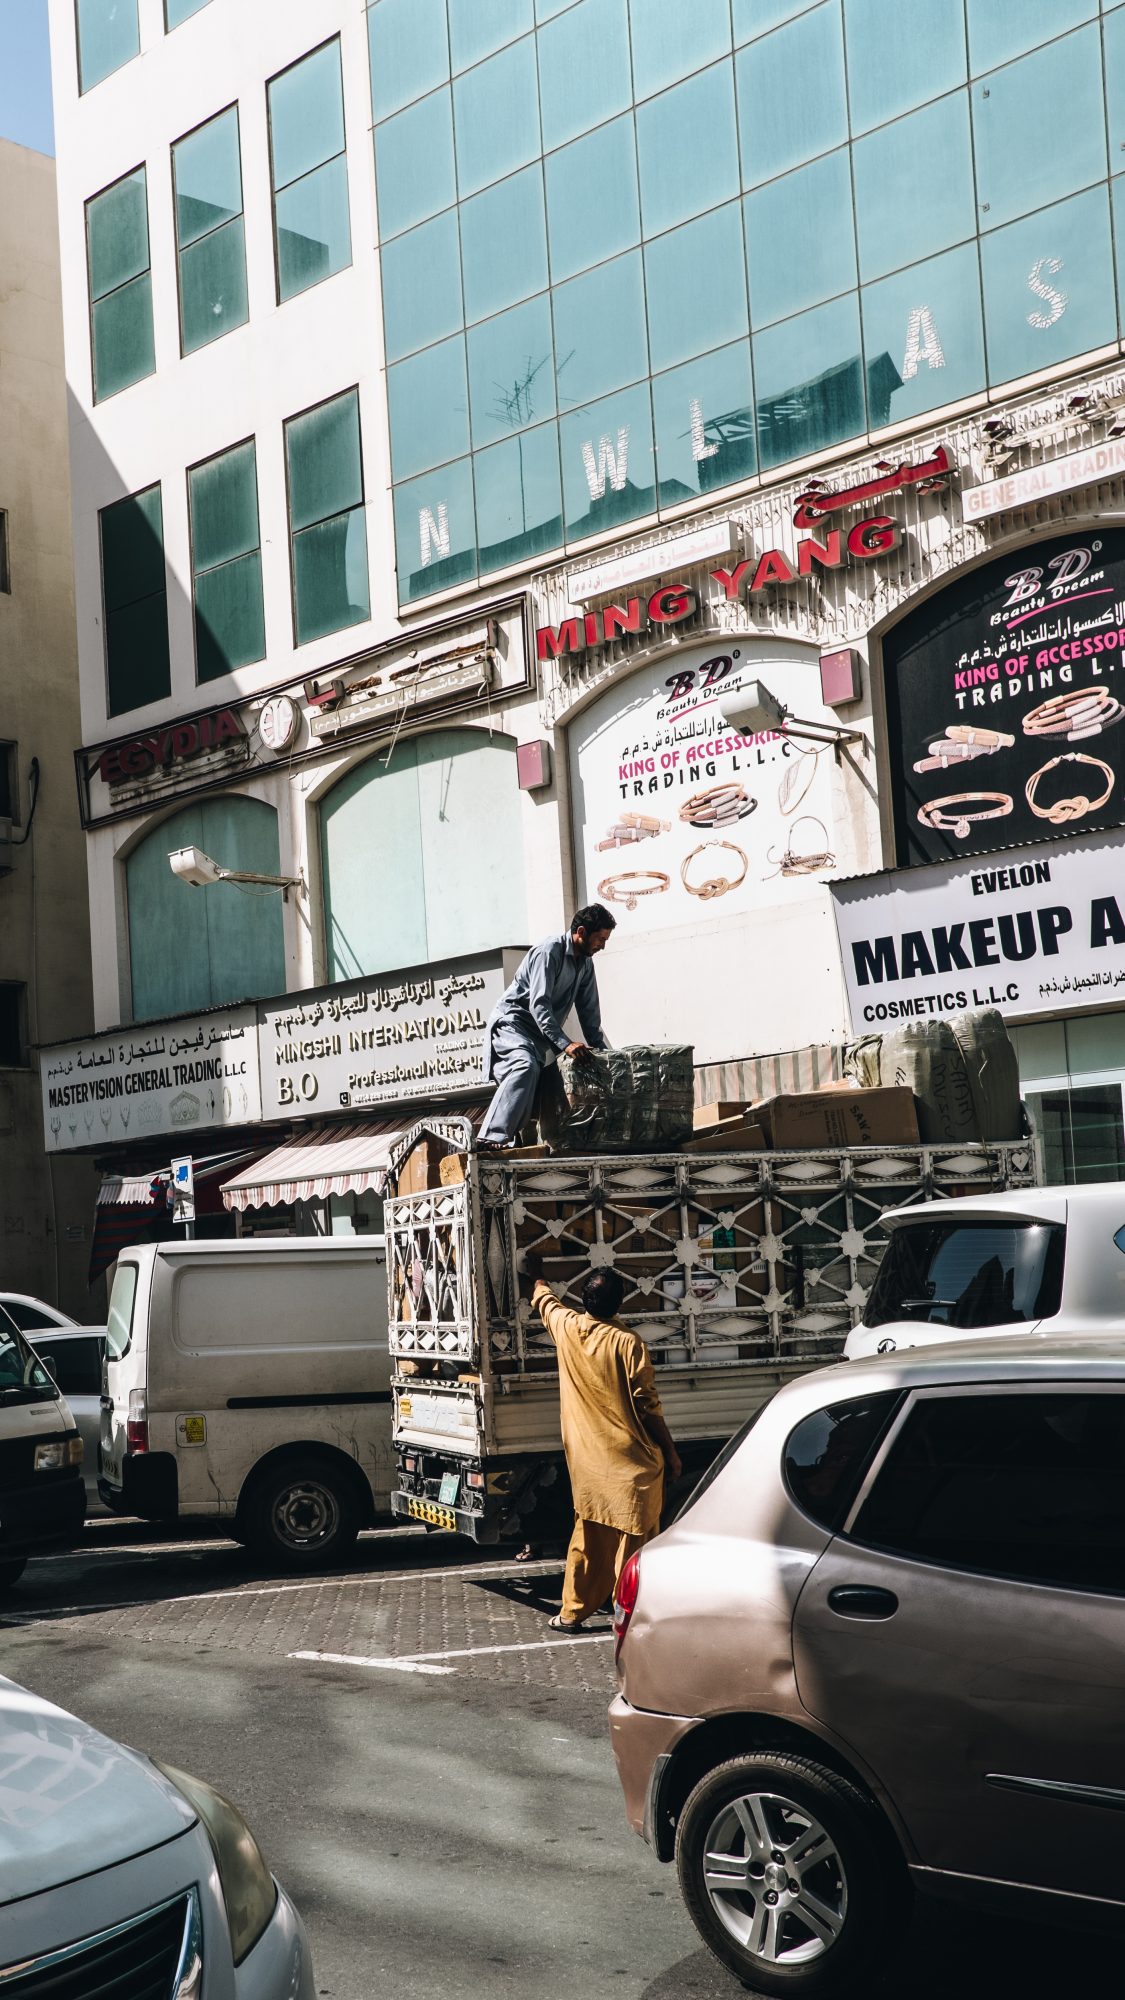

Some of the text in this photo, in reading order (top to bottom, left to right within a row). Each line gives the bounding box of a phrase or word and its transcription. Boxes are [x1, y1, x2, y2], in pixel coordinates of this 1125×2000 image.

[418, 499, 451, 566] N
[579, 424, 631, 502] W
[903, 304, 946, 382] A
[1026, 256, 1070, 330] S
[967, 470, 1052, 513] GENERAL
[536, 515, 902, 661] MING YANG
[990, 570, 1105, 626] Beauty Dream
[1010, 622, 1048, 652] للتجارة
[954, 663, 999, 690] KING
[1005, 654, 1030, 676] OF
[955, 664, 1073, 710] TRADING
[656, 676, 743, 721] Beauty Dream
[99, 708, 246, 783] EGYDIA
[665, 721, 696, 747] للتجارة
[618, 757, 656, 781] KING
[661, 750, 680, 769] OF
[619, 761, 717, 800] TRADING
[971, 861, 1052, 896] EVELON
[851, 905, 1073, 986] MAKEUP
[863, 982, 1020, 1023] COSMETICS L.L.C
[1072, 972, 1102, 993] التجميل
[119, 1036, 166, 1066] للتجارة
[274, 1008, 487, 1065] MINGSHI INTERNATIONAL
[77, 1047, 115, 1070] العامة
[348, 1058, 427, 1089] Professional
[48, 1057, 247, 1108] MASTER VISION GENERAL TRADING L.L.C
[276, 1070, 319, 1105] B.O
